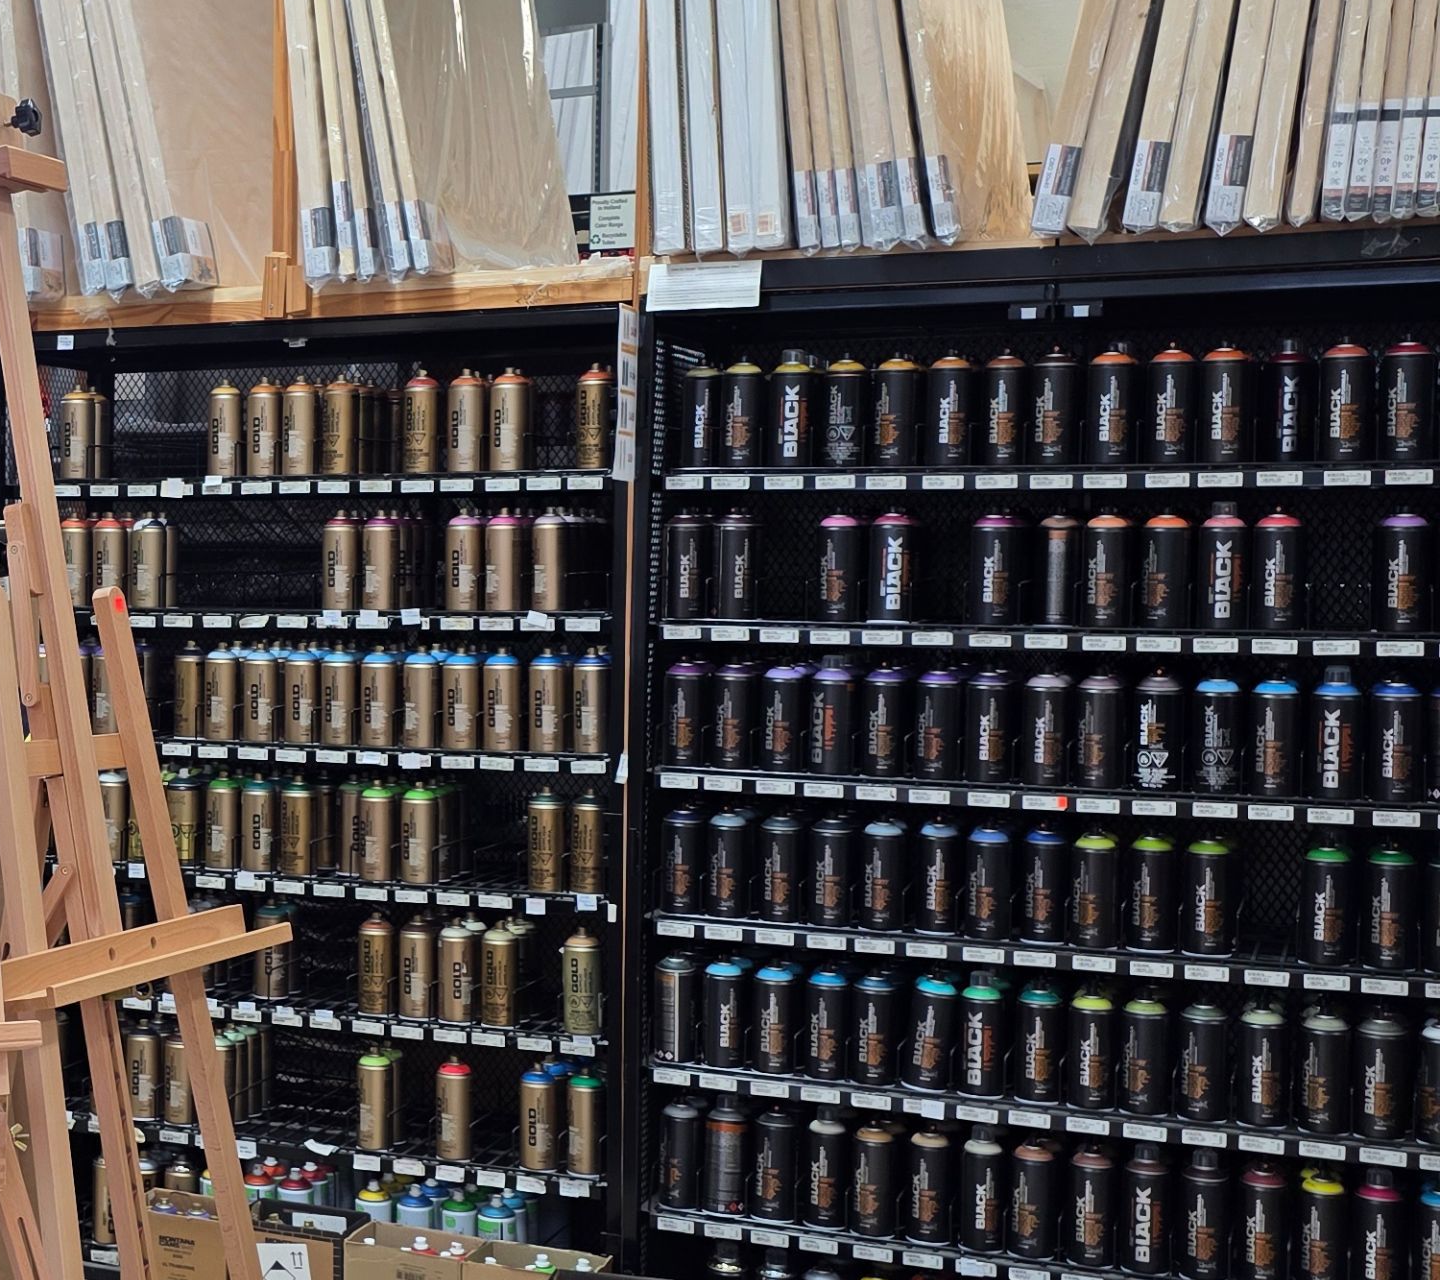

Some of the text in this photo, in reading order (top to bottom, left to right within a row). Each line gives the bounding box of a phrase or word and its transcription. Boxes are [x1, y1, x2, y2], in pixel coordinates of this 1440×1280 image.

[451, 411, 459, 448] GOLD
[694, 404, 705, 448] BLACK
[783, 384, 800, 458] BLACK
[938, 397, 950, 444] BLACK
[989, 398, 999, 444] BLACK
[1099, 393, 1112, 442] BLACK
[1156, 392, 1167, 441] BLACK
[1211, 390, 1222, 440] BLACK
[1282, 375, 1300, 453] BLACK
[1330, 388, 1341, 438] BLACK
[1387, 387, 1397, 437] BLACK
[886, 536, 903, 610] BLACK
[983, 556, 993, 602] BLACK
[1214, 540, 1232, 618] BLACK
[1264, 558, 1276, 607] BLACK
[1388, 558, 1399, 608] BLACK
[534, 690, 542, 728] GOLD
[812, 692, 824, 764] BLACK
[1034, 717, 1045, 763] BLACK
[1323, 709, 1341, 788] BLACK
[1382, 728, 1394, 778] BLACK
[252, 814, 261, 850] GOLD
[926, 865, 937, 910] BLACK
[1195, 884, 1206, 932] BLACK
[1314, 892, 1326, 941] BLACK
[453, 962, 461, 999] GOLD
[486, 950, 494, 985] GOLD
[571, 958, 579, 993] GOLD
[913, 1020, 927, 1065] BLACK
[967, 1011, 982, 1086] BLACK
[1026, 1033, 1036, 1079] BLACK
[1080, 1039, 1091, 1087] BLACK
[1252, 1055, 1262, 1103] BLACK
[1364, 1065, 1376, 1114] BLACK
[528, 1108, 537, 1147] GOLD
[976, 1184, 987, 1229] BLACK
[1076, 1196, 1086, 1242] BLACK
[1135, 1186, 1151, 1263] BLACK
[1245, 1215, 1256, 1263] BLACK
[1365, 1230, 1377, 1280] BLACK
